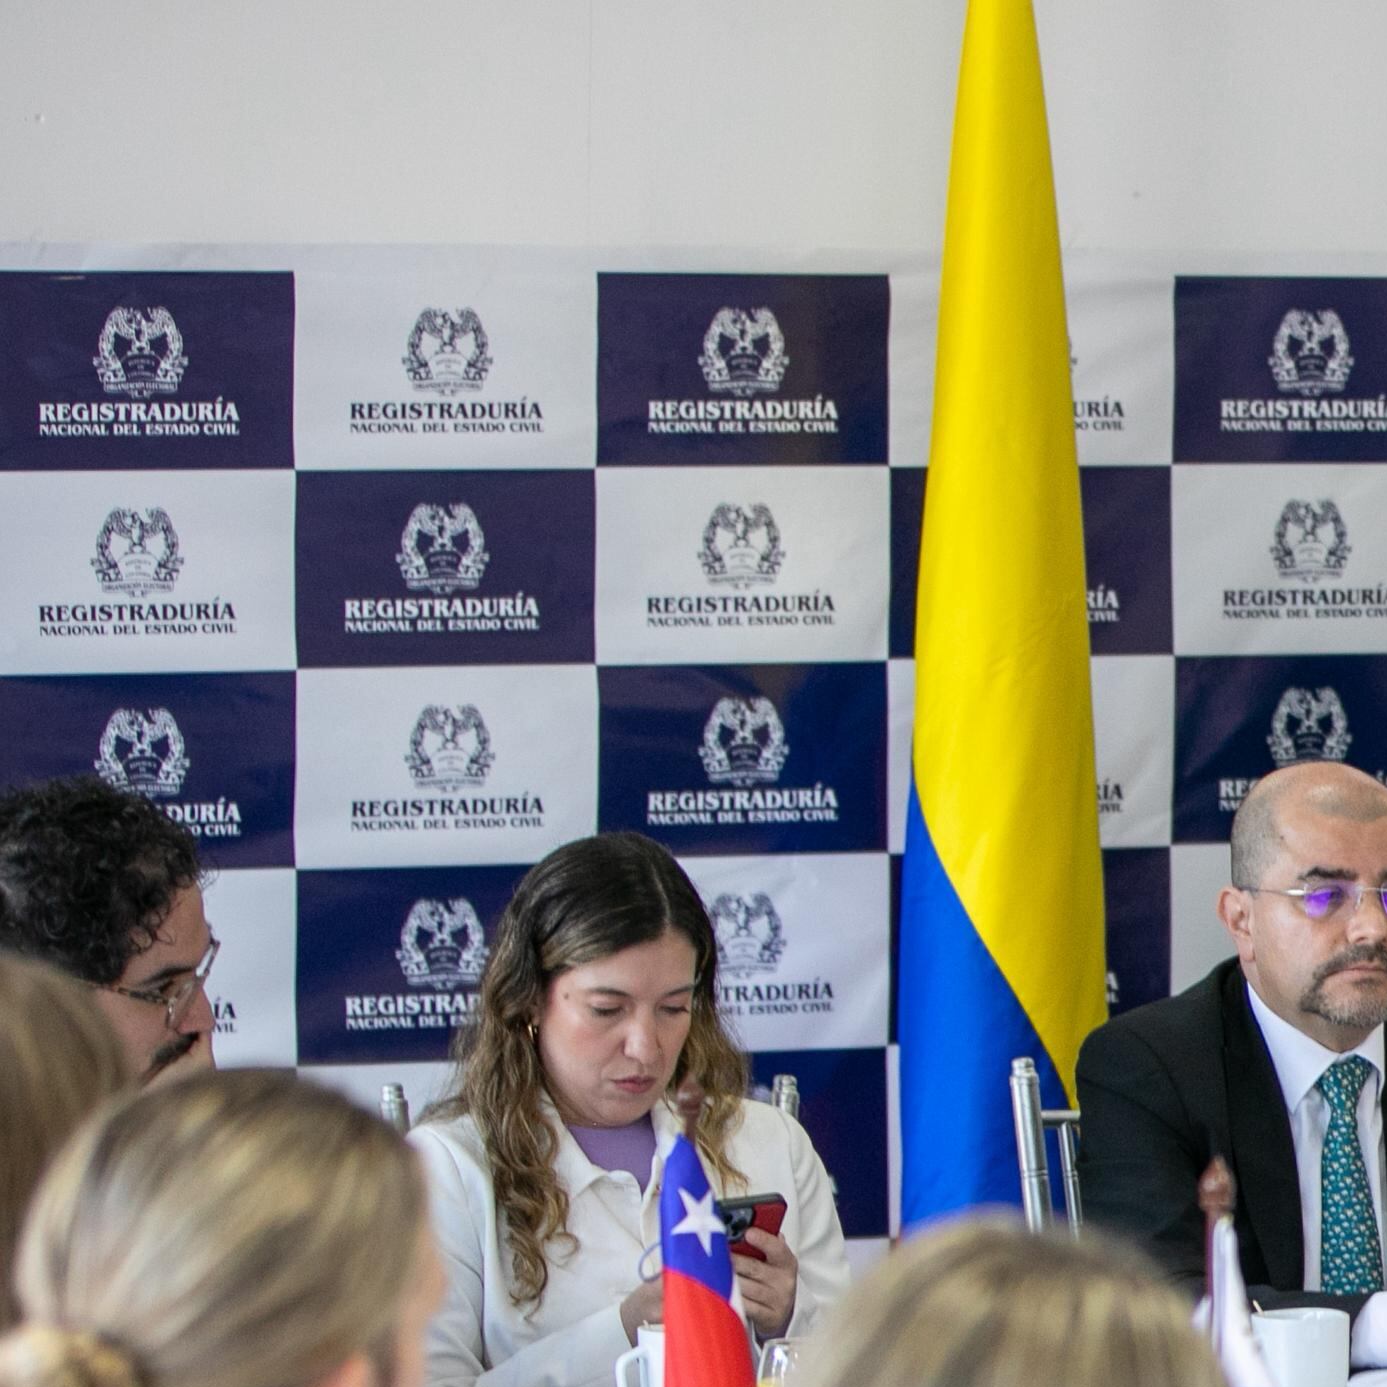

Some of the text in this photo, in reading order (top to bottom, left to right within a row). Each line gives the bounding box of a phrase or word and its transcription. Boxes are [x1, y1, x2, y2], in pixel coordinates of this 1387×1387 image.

[39, 396, 239, 422] REGISTRADURÍA
[350, 396, 543, 419] REGISTRADURÍA
[648, 393, 838, 419] REGISTRADURÍA
[39, 423, 240, 436] NACIONAL DEL ESTADO CIVIL
[350, 422, 544, 433] NACIONAL DEL ESTADO CIVIL
[648, 421, 838, 433] NACIONAL DEL ESTADO CIVIL
[1093, 420, 1124, 430] CIVIL
[1220, 420, 1282, 431] NACIONAL
[1286, 420, 1312, 431] DEL
[1316, 420, 1365, 431] ESTADO
[345, 591, 539, 618] REGISTRADURÍA
[647, 589, 835, 613] REGISTRADURÍA
[39, 596, 236, 622] REGISTRADURÍA
[1223, 608, 1283, 620] NACIONAL
[1287, 608, 1311, 619] DEL
[1315, 608, 1363, 619] ESTADO
[345, 618, 539, 632] NACIONAL DEL ESTADO CIVIL
[647, 615, 835, 627] NACIONAL DEL ESTADO CIVIL
[39, 623, 237, 636] NACIONAL DEL ESTADO CIVIL
[647, 782, 838, 811] REGISTRADURÍA
[352, 792, 544, 817] REGISTRADURÍA
[647, 809, 838, 825] NACIONAL DEL ESTADO CIVIL
[205, 824, 241, 837] CIVIL
[352, 817, 544, 832] NACIONAL DEL ESTADO CIVIL
[749, 1004, 797, 1015] ESTADO
[802, 1002, 834, 1013] CIVIL
[346, 1017, 414, 1030] NACIONAL
[418, 1016, 446, 1027] DEL
